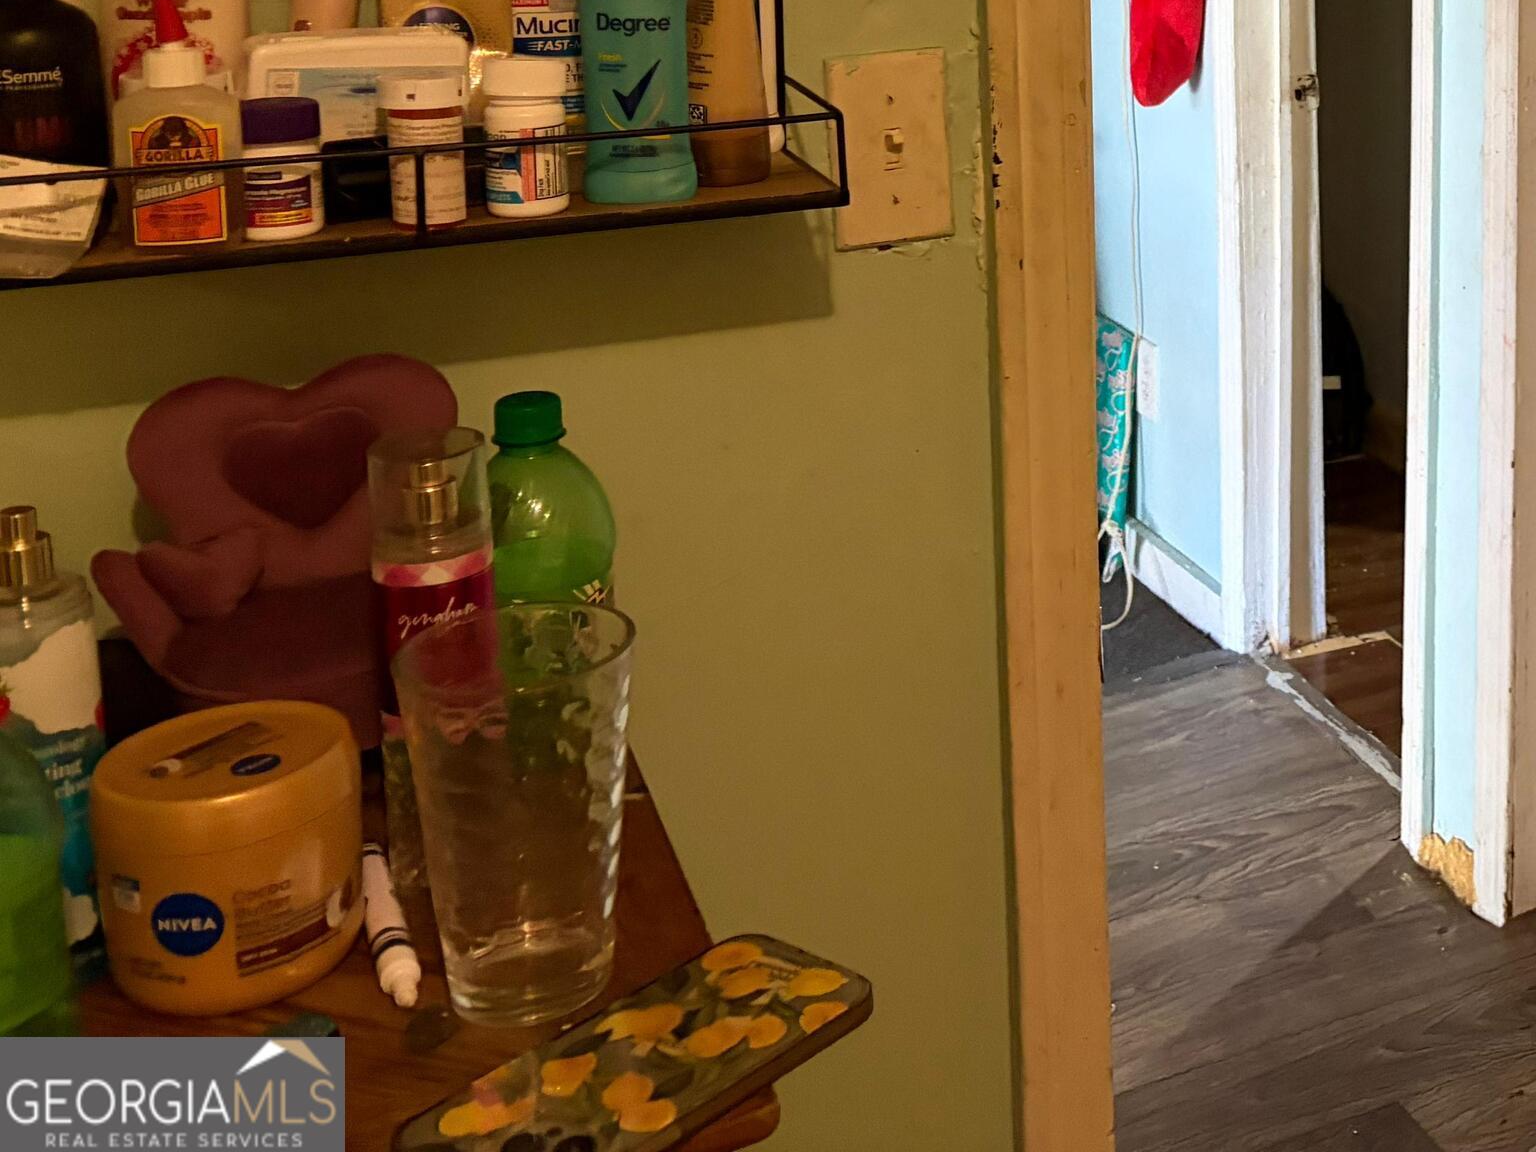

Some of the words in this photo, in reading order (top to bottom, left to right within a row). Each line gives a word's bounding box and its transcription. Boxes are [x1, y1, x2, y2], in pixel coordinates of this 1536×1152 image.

[596, 13, 671, 37] Degree
[0, 65, 63, 85] Semmé
[145, 148, 204, 162] GORILLA
[136, 181, 182, 202] GORILLA
[184, 173, 214, 190] GLUE
[158, 916, 217, 932] NIVEA
